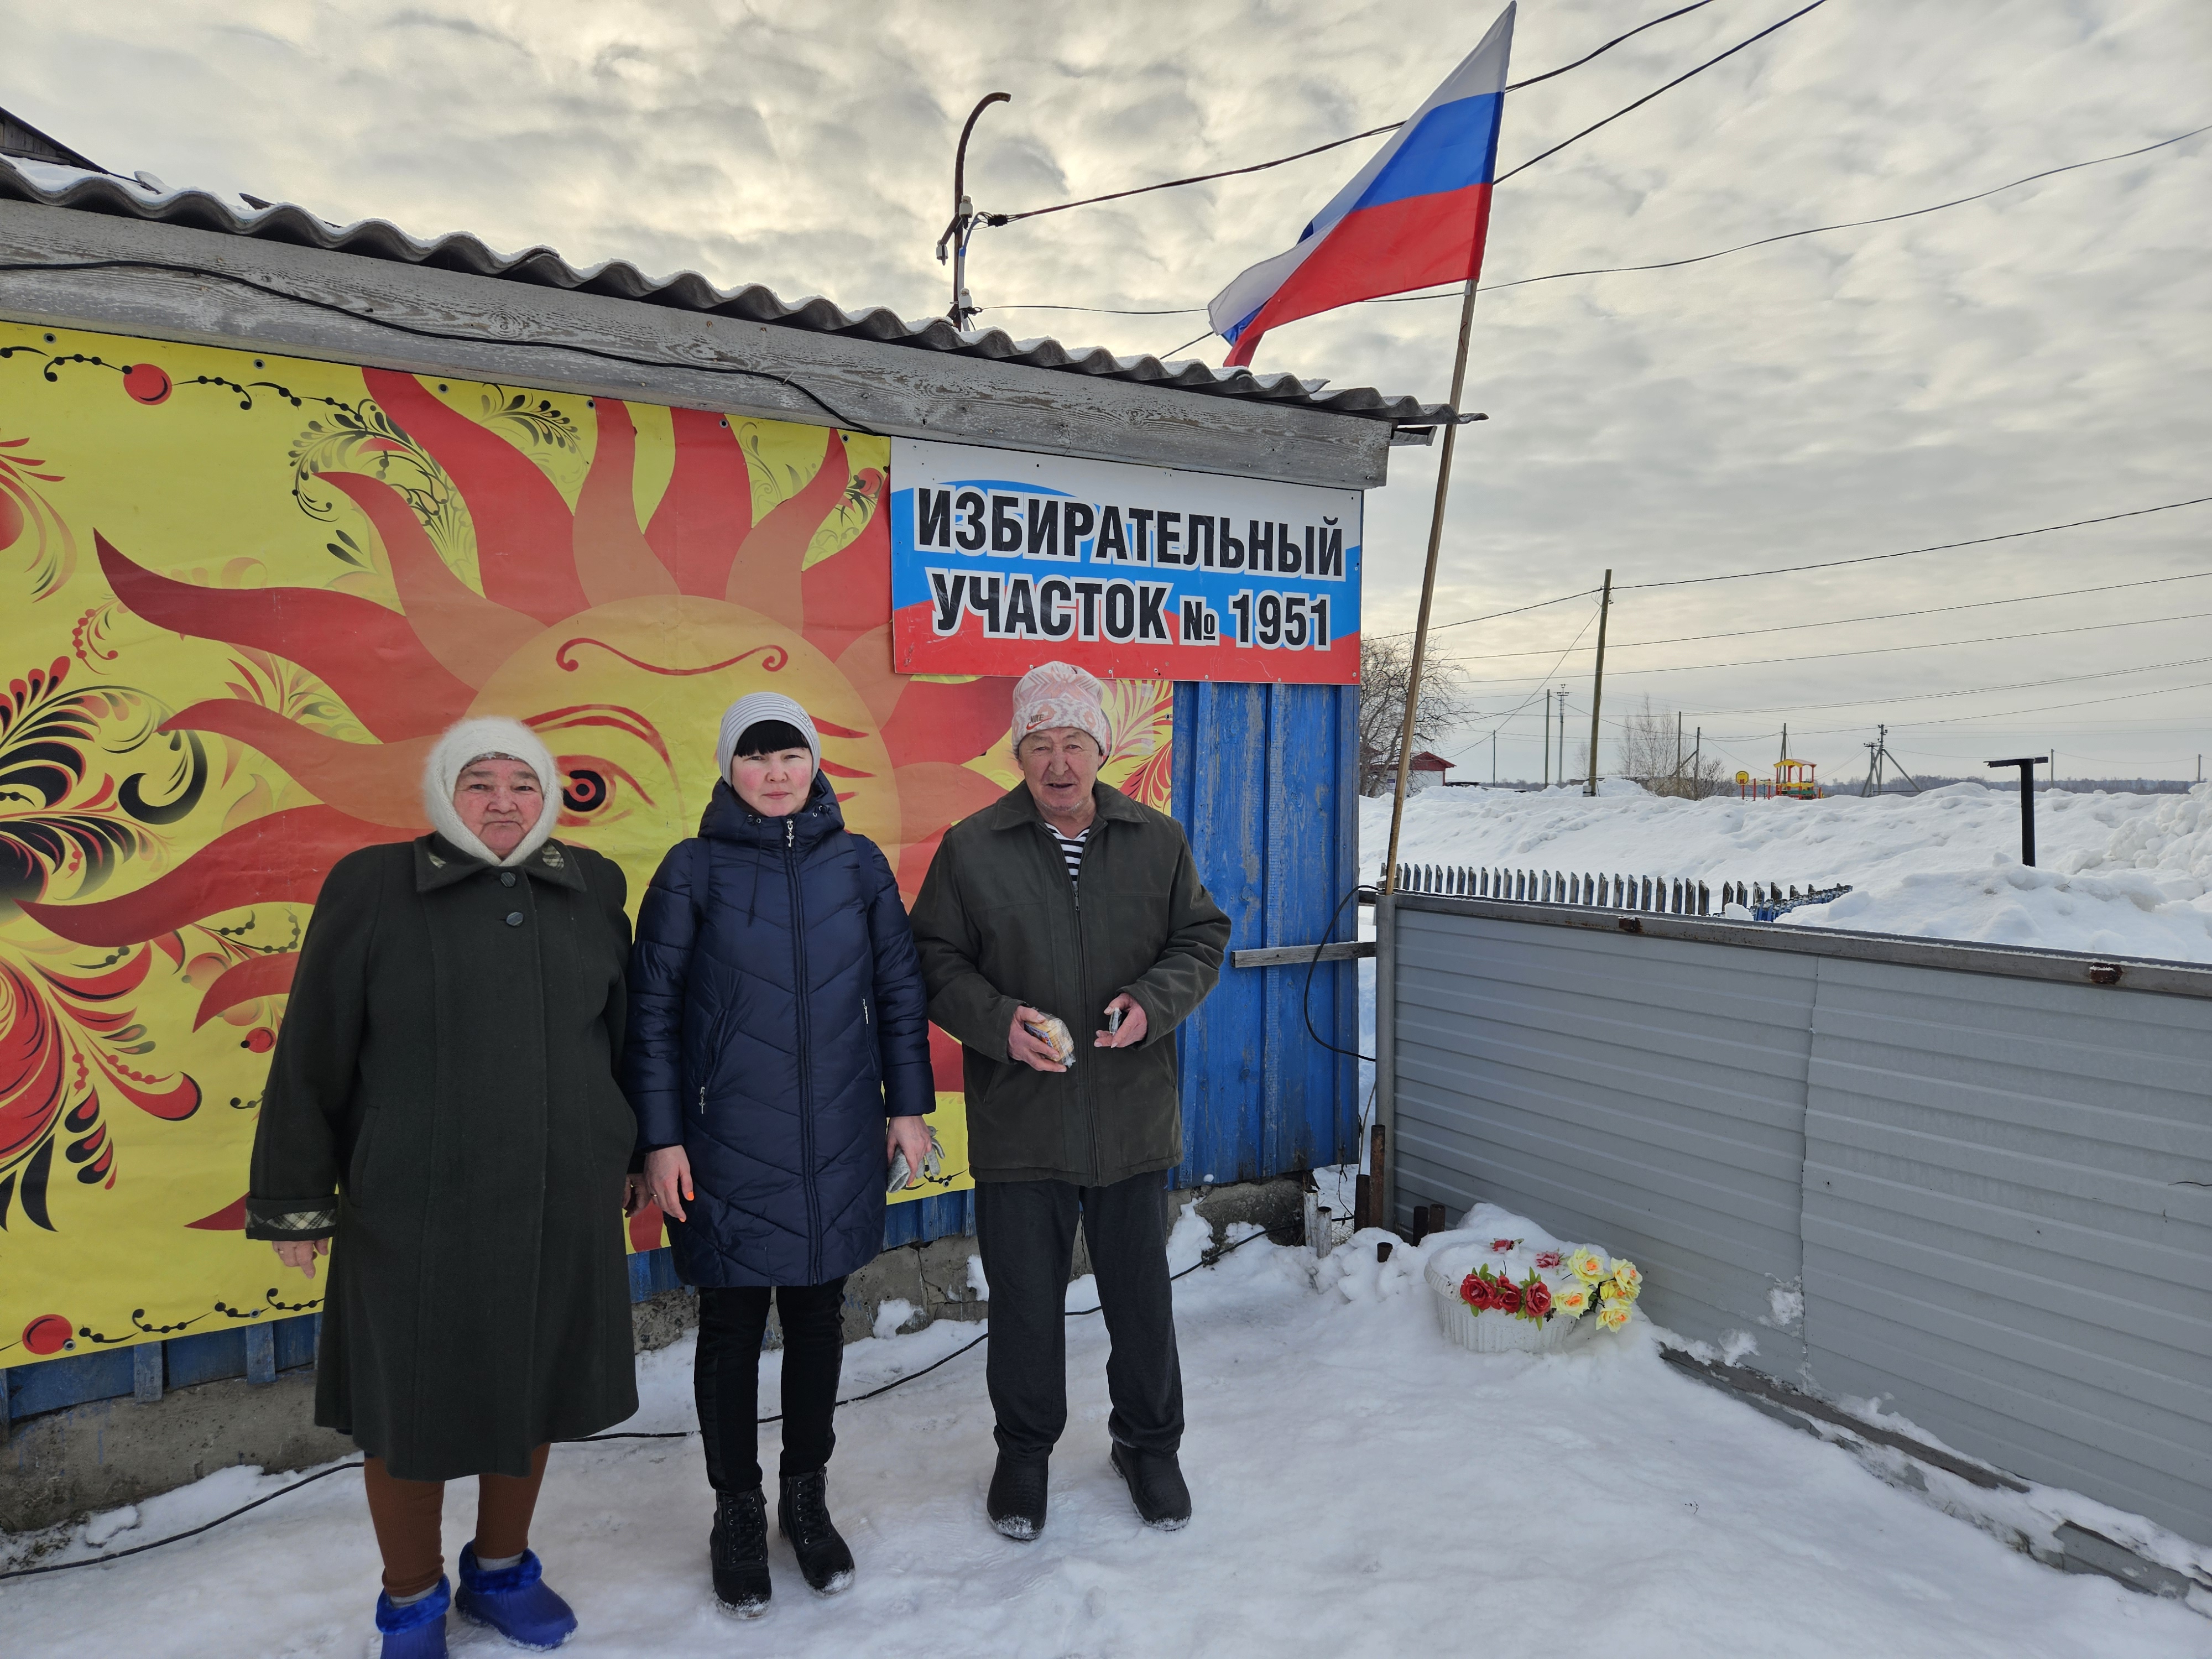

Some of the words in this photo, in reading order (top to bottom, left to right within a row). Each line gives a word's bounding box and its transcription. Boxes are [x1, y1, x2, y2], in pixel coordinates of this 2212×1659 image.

[919, 487, 1342, 576] ИЗБИРАТЕЛЬНЫЙ
[931, 573, 1167, 639] УЧАСТОК
[1183, 601, 1215, 641] №
[1233, 594, 1327, 646] 1951
[1030, 714, 1044, 723] NIKE
